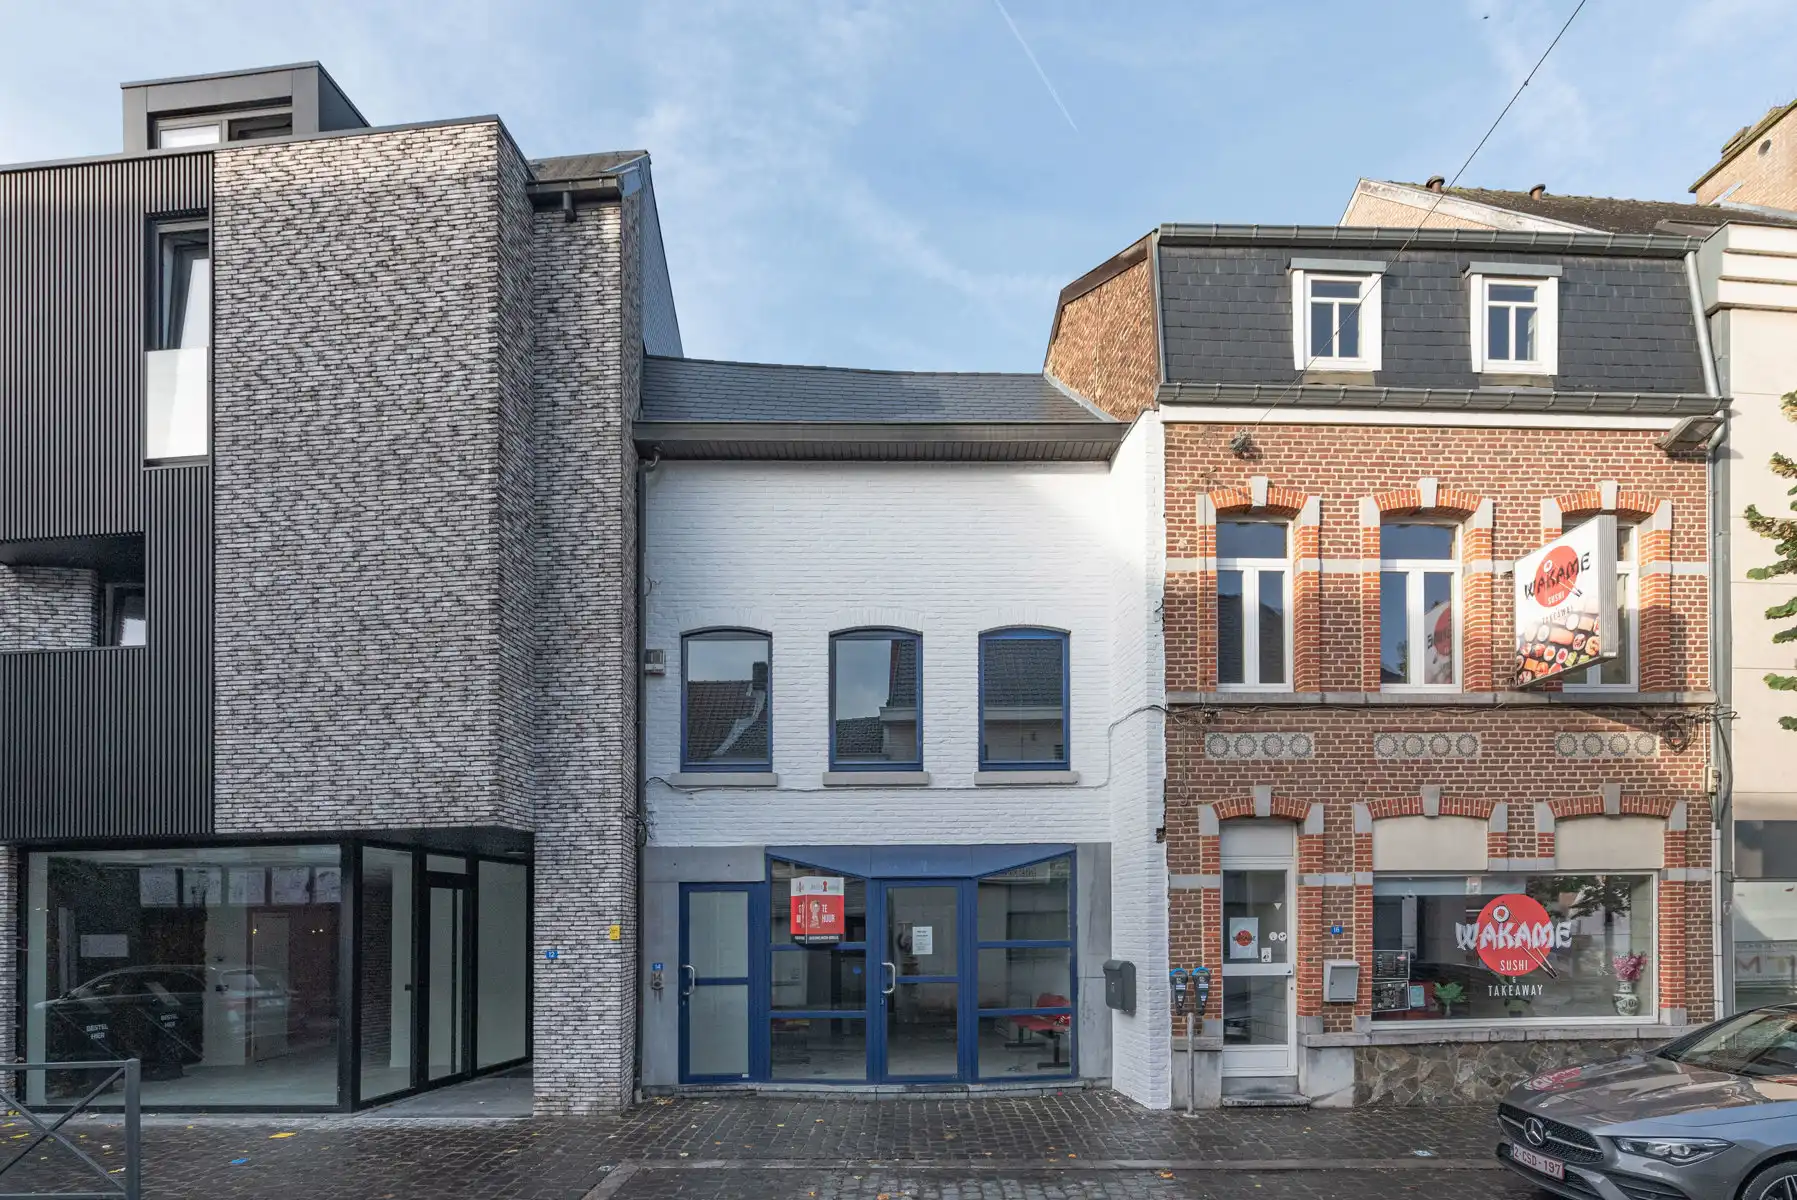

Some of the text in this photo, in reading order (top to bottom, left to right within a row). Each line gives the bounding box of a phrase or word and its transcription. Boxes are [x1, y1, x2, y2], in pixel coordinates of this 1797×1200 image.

[1524, 552, 1590, 600] WAKAME
[1547, 591, 1565, 605] SUSHI
[1455, 921, 1572, 951] WAKAME
[1500, 960, 1528, 971] SUSHI
[1488, 985, 1543, 997] TAKEAWAY
[86, 1024, 108, 1032] BESTEL
[90, 1032, 105, 1040] HIER
[1514, 1146, 1561, 1175] 2-CSD-197
